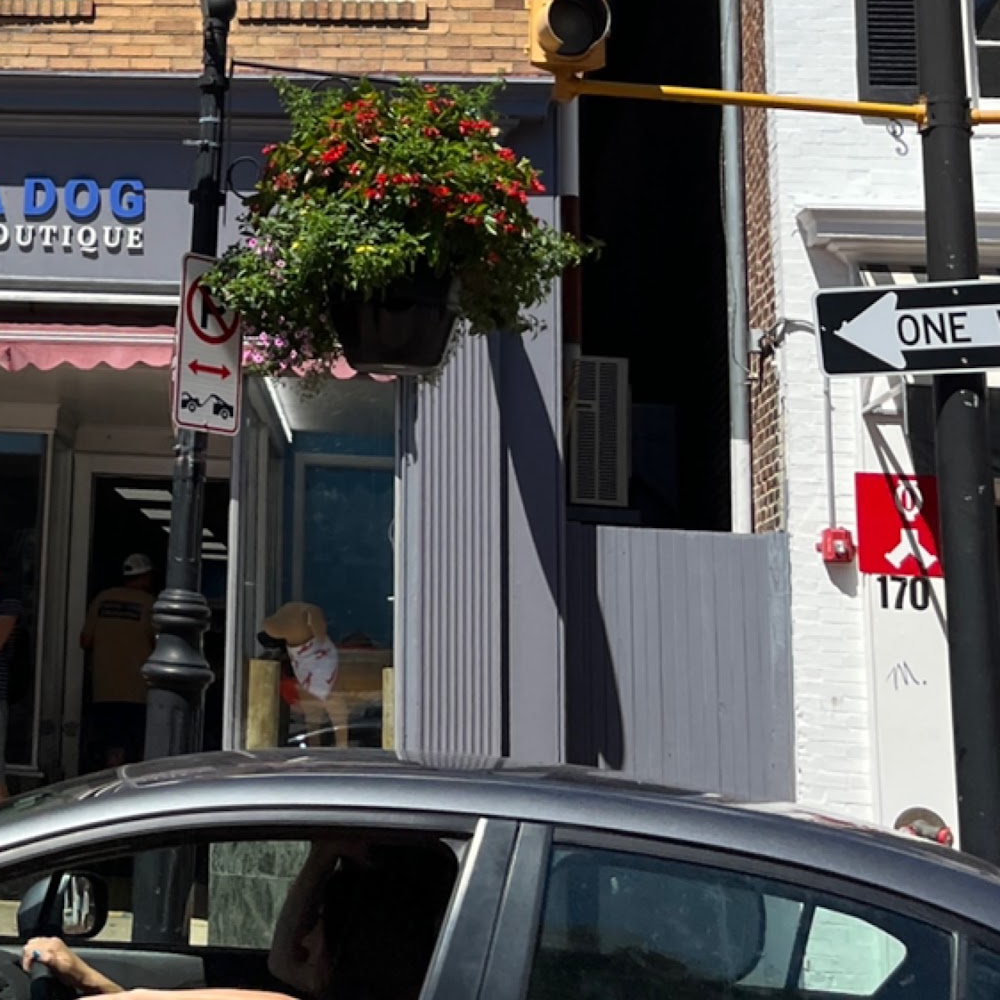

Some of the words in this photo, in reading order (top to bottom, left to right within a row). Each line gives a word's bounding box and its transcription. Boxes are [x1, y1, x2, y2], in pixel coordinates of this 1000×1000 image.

[24, 176, 146, 219] DOG
[897, 311, 972, 346] ONE
[876, 576, 930, 611] 170
